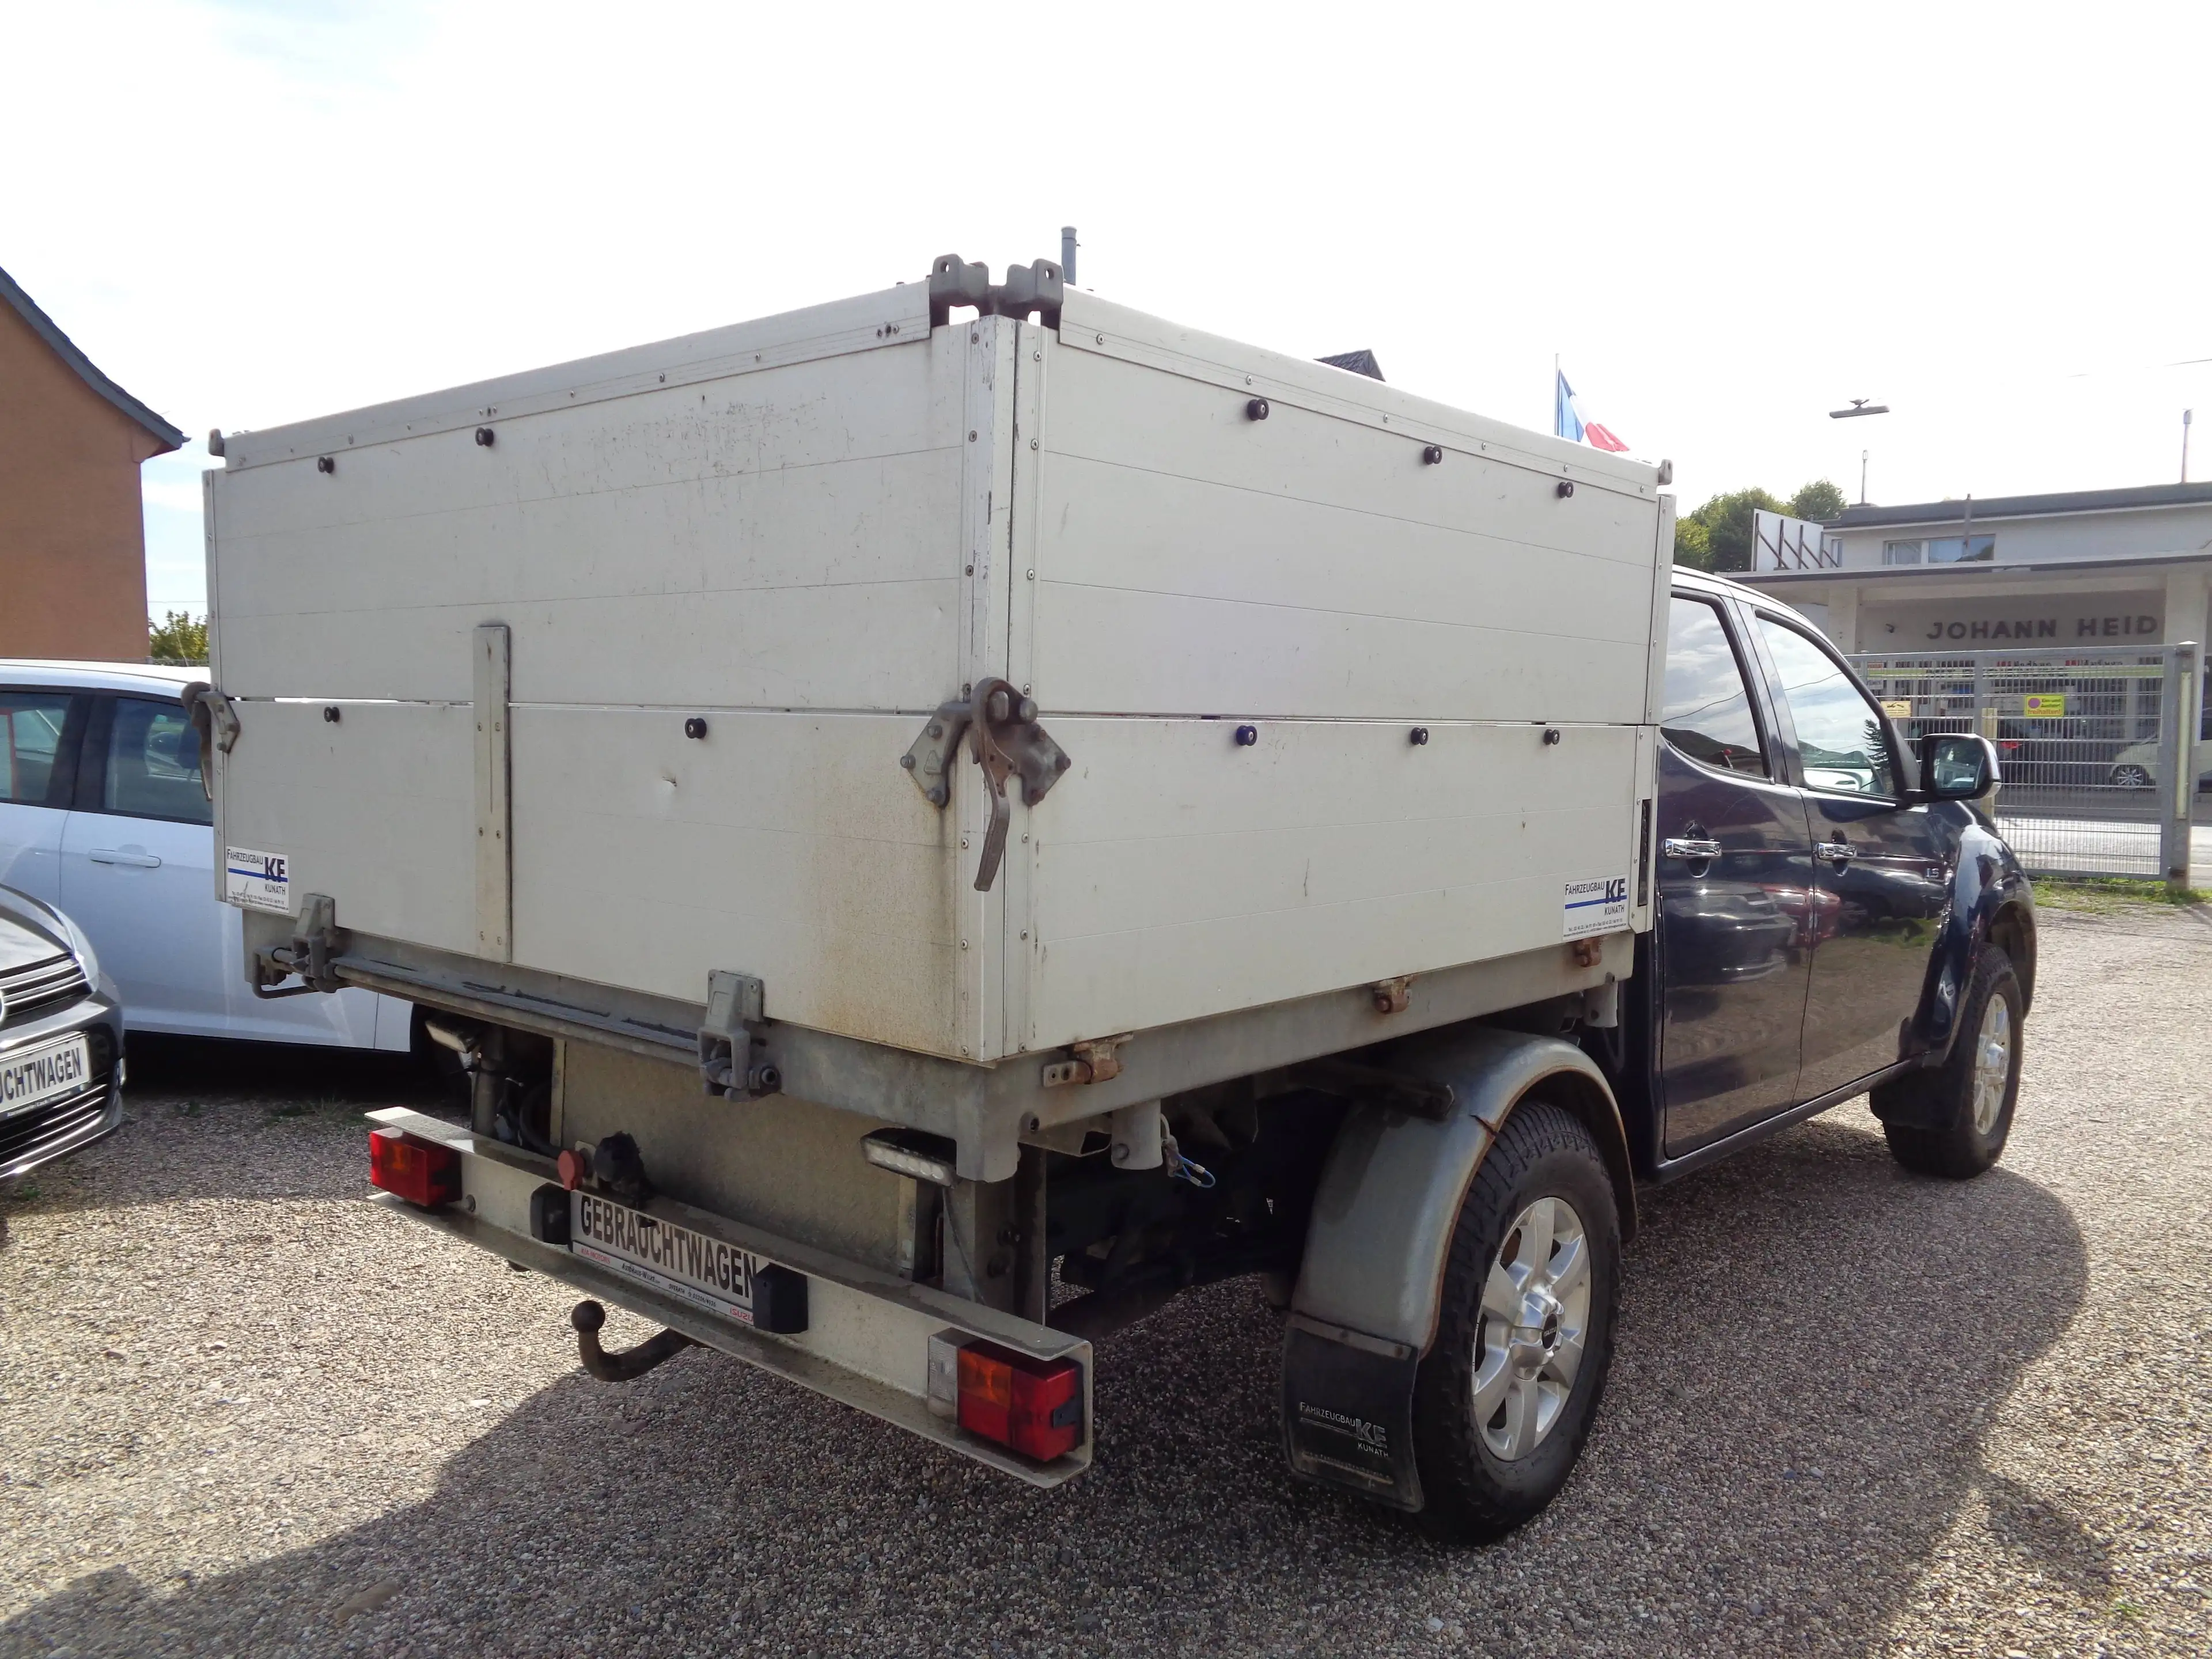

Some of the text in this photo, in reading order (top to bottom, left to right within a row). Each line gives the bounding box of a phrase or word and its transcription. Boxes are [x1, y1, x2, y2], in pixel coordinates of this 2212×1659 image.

[1927, 615, 2157, 639] JOHANN HEID
[227, 849, 263, 865] FAHRZEUGBAU
[264, 883, 286, 895] KUNATH
[1565, 881, 1605, 895] FAHRZEUGBAU
[1604, 904, 1624, 915] KUNATH
[581, 1195, 756, 1298] GEBRAUCHTWAGEN
[730, 1307, 753, 1322] ISUZU
[1300, 1402, 1355, 1427] FAHRZEUGBAU
[1358, 1442, 1389, 1458] KUNATH
